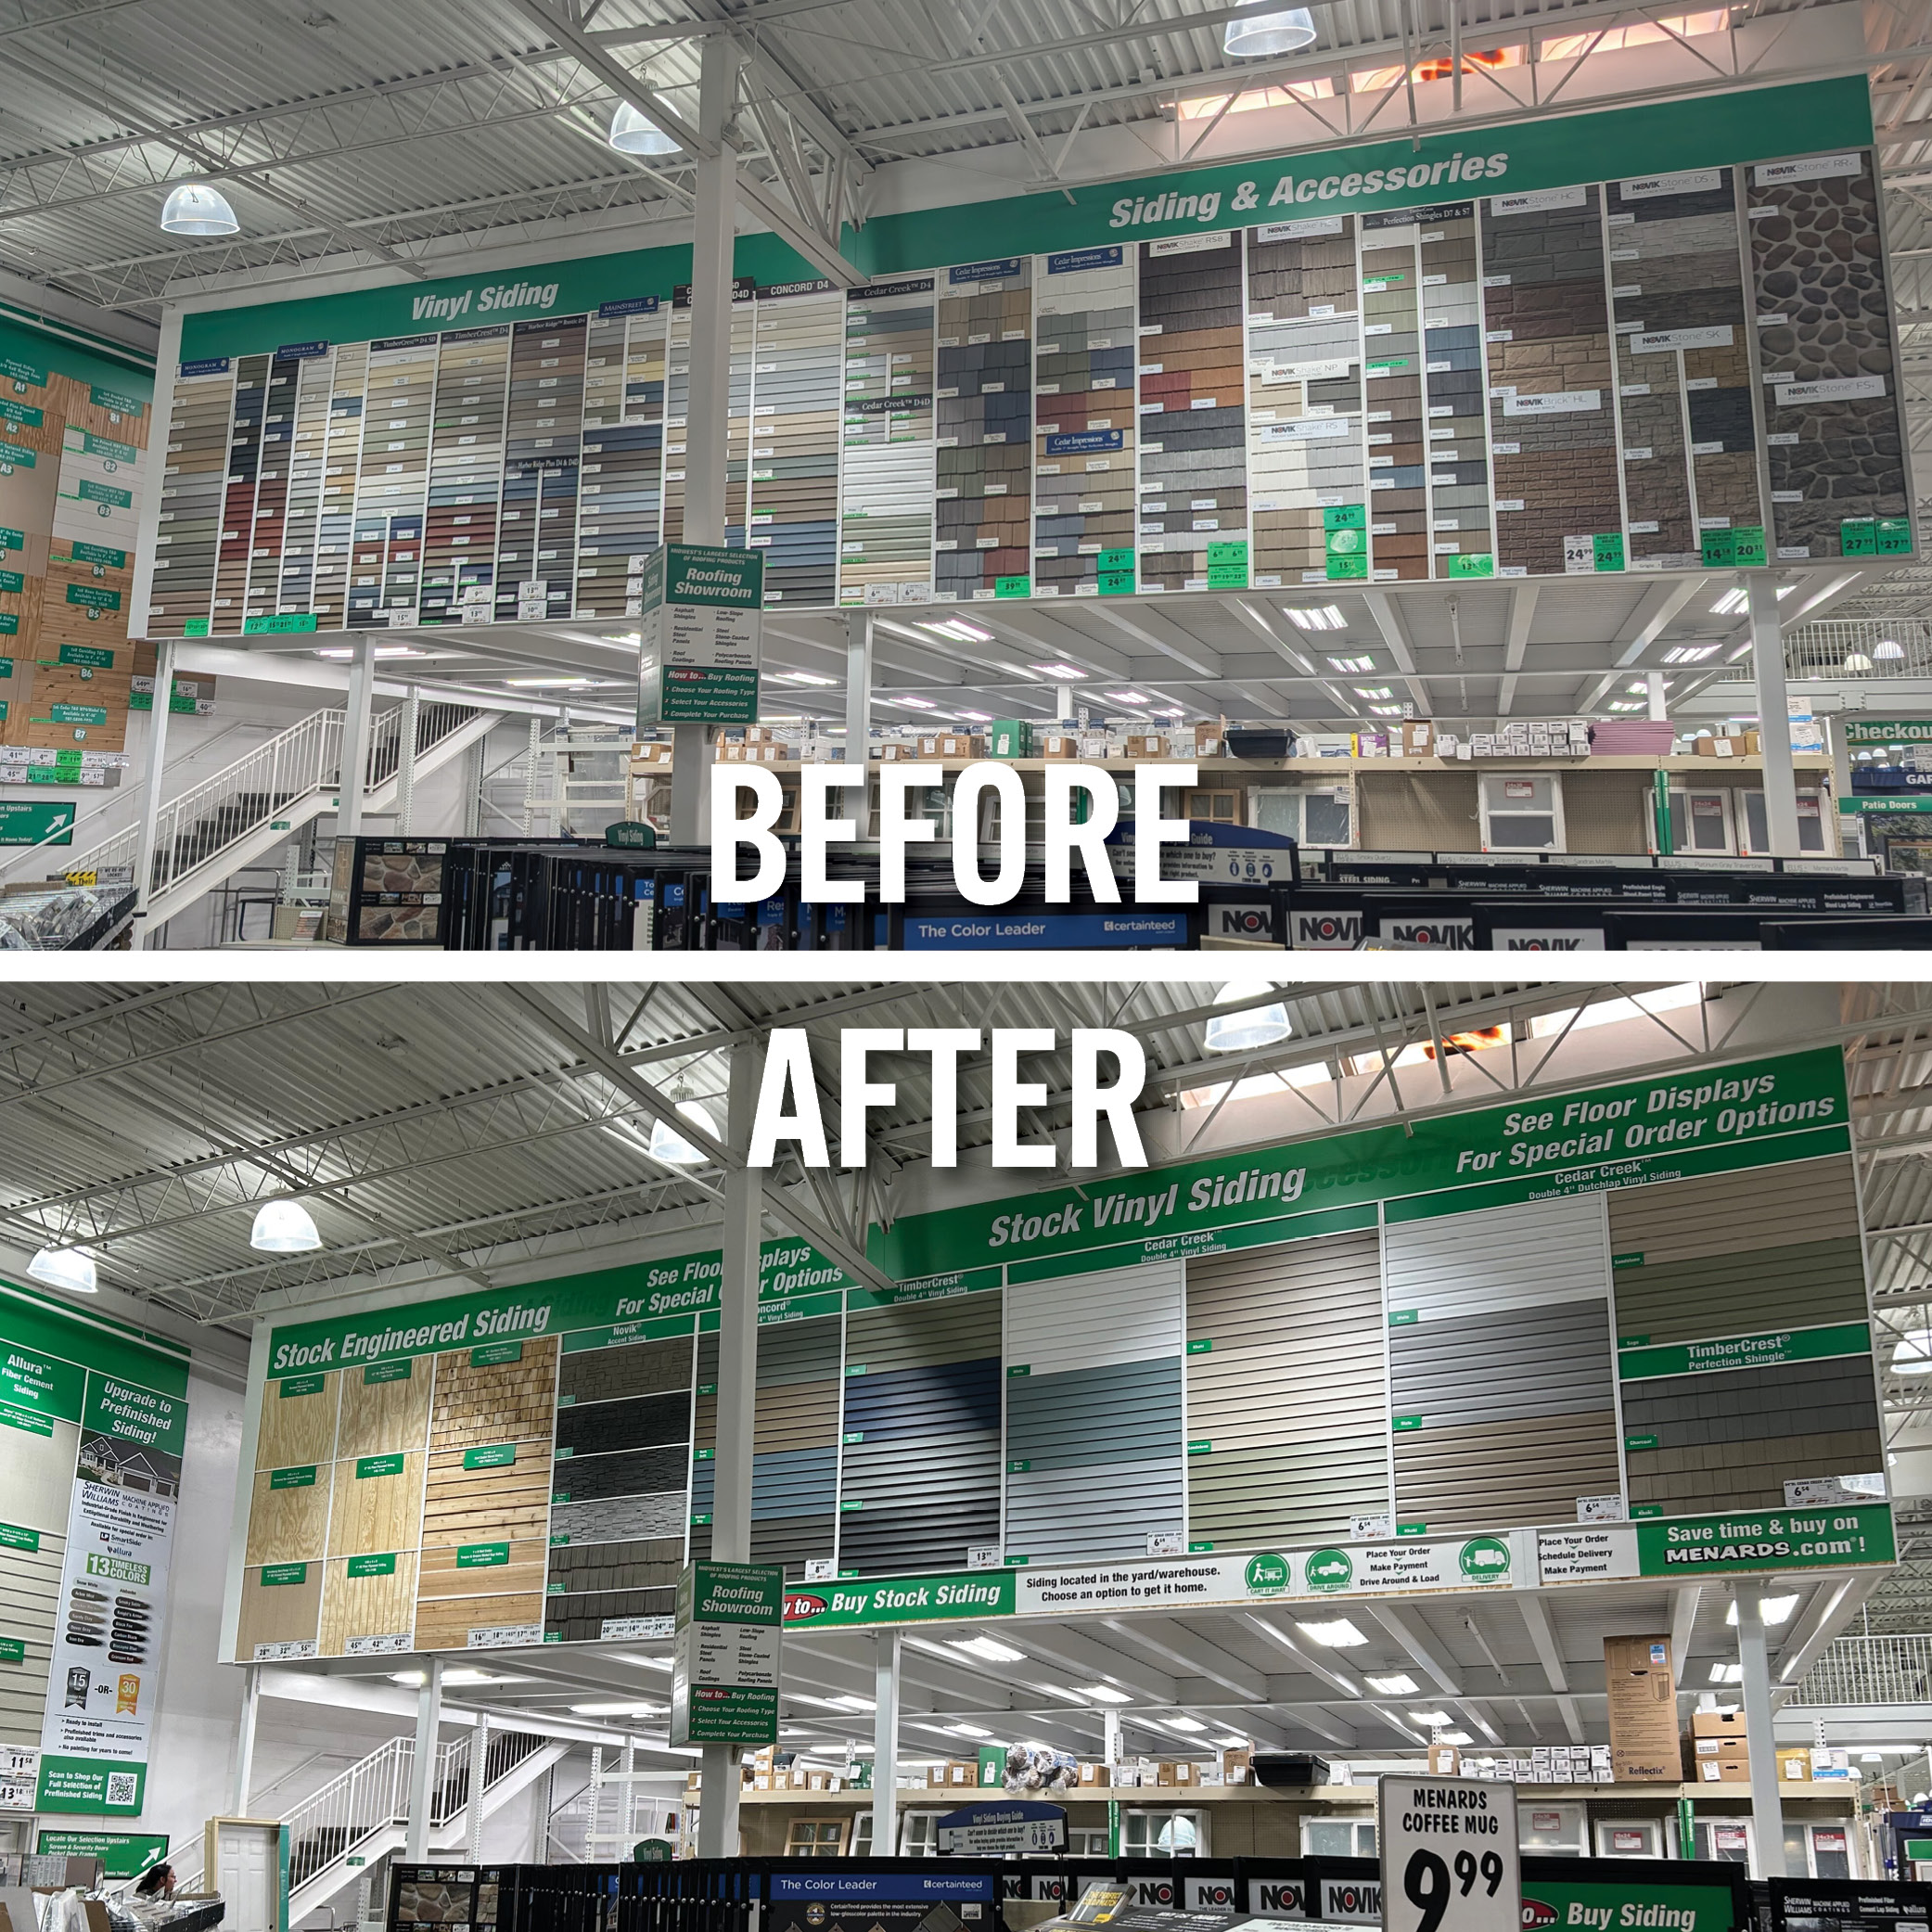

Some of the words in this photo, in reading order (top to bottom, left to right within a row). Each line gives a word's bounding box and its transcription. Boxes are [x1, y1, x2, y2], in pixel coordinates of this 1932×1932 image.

[1109, 191, 1222, 228] Siding
[1231, 182, 1260, 210] &
[1270, 153, 1509, 207] Accessories
[1383, 214, 1414, 225] Perfection
[1415, 211, 1442, 222] Shingles
[817, 280, 829, 289] D4
[412, 290, 472, 321] Vinyl
[477, 282, 558, 312] Siding
[281, 346, 315, 354] MONOGRAM
[185, 363, 218, 372] MONOGRAM
[862, 401, 882, 410] Cedar
[686, 568, 742, 585] Roofing
[674, 582, 752, 598] Showroom
[668, 671, 688, 679] How
[708, 672, 723, 682] Buy
[725, 673, 755, 683] Roofing
[1846, 723, 1932, 739] Checkou
[6, 805, 32, 813] Upstairs
[1862, 801, 1887, 810] Patio
[1888, 800, 1917, 810] Doors
[918, 925, 947, 939] The
[951, 924, 990, 937] Color
[993, 922, 1046, 936] Leader
[1114, 919, 1175, 932] certainteed
[1503, 1110, 1553, 1136] See
[1562, 1095, 1637, 1127] Floor
[1646, 1073, 1775, 1114] Displays
[1455, 1148, 1502, 1173] For
[1508, 1127, 1611, 1168] Special
[1625, 1116, 1708, 1148] Order
[1716, 1096, 1835, 1136] Options
[1555, 1167, 1596, 1184] Cedar
[1529, 1188, 1561, 1200] Double
[1578, 1178, 1620, 1194] Dutchlap
[1622, 1173, 1647, 1186] Vinyl
[1649, 1169, 1681, 1183] Siding
[989, 1202, 1084, 1248] Stock
[1094, 1184, 1178, 1228] Vinyl
[1187, 1167, 1307, 1211] Siding
[1145, 1236, 1178, 1251] Cedar
[647, 1265, 681, 1289] See
[685, 1259, 723, 1283] Floo
[616, 1297, 643, 1316] For
[648, 1287, 712, 1315] Special
[774, 1267, 843, 1293] Options
[274, 1337, 334, 1370] Stock
[339, 1318, 468, 1361] Engineered
[475, 1304, 551, 1338] Siding
[608, 1336, 631, 1344] Accent
[632, 1333, 646, 1342] Siding
[1688, 1356, 1742, 1371] Perfection
[2, 1367, 22, 1381] Fiber
[23, 1374, 54, 1391] Cement
[13, 1384, 39, 1400] Siding
[104, 1381, 157, 1409] Upgrade
[160, 1399, 173, 1414] to
[100, 1398, 173, 1431] Prefinished
[112, 1419, 158, 1443] Siding!
[84, 1481, 121, 1498] SHERWIN
[82, 1490, 119, 1507] WILLIAMS
[1668, 1526, 1713, 1542] Save
[1719, 1522, 1762, 1538] time
[1769, 1519, 1784, 1535] &
[1790, 1517, 1826, 1535] buy
[1834, 1516, 1859, 1530] on
[112, 1546, 132, 1557] allura
[1366, 1550, 1388, 1559] Place
[1389, 1548, 1407, 1557] Your
[1409, 1547, 1431, 1556] Order
[1538, 1551, 1576, 1561] Schedule
[1578, 1548, 1613, 1559] Delivery
[90, 1556, 109, 1576] 13
[111, 1559, 147, 1574] TIMELESS
[1370, 1563, 1392, 1571] Make
[1393, 1561, 1428, 1572] Payment
[110, 1569, 147, 1584] COLORS
[1027, 1577, 1057, 1589] Siding
[1060, 1575, 1095, 1587] located
[1098, 1574, 1109, 1584] in
[1112, 1571, 1129, 1582] the
[1131, 1566, 1221, 1581] yard/warehouse.
[1360, 1578, 1380, 1586] Drive
[1382, 1576, 1411, 1585] Around
[1412, 1575, 1418, 1583] &
[1420, 1574, 1439, 1583] Load
[712, 1585, 763, 1603] Roofing
[832, 1593, 864, 1614] Buy
[873, 1587, 928, 1609] Stock
[935, 1583, 1001, 1606] Siding
[1042, 1590, 1078, 1602] Choose
[1081, 1591, 1094, 1600] an
[1096, 1587, 1127, 1601] option
[1131, 1587, 1142, 1597] to
[1145, 1586, 1161, 1598] get
[1164, 1584, 1171, 1594] it
[1173, 1582, 1208, 1593] home.
[701, 1599, 774, 1616] Showroom
[72, 1673, 86, 1687] 15
[122, 1682, 136, 1694] 30
[48, 1771, 65, 1779] Scan
[74, 1772, 91, 1783] Shop
[62, 1781, 92, 1790] Selection
[44, 1789, 82, 1798] Prefinished
[83, 1792, 103, 1800] Siding
[1414, 1789, 1488, 1810] MENARDS
[1402, 1812, 1459, 1836] COFFEE
[1465, 1813, 1499, 1836] MUG
[46, 1835, 66, 1843] Locate
[781, 1879, 801, 1889] The
[805, 1879, 835, 1889] Color
[838, 1879, 877, 1890] Leader
[931, 1879, 983, 1889] certainteed
[1567, 1903, 1615, 1928] Buy
[1619, 1904, 1696, 1932] Siding
